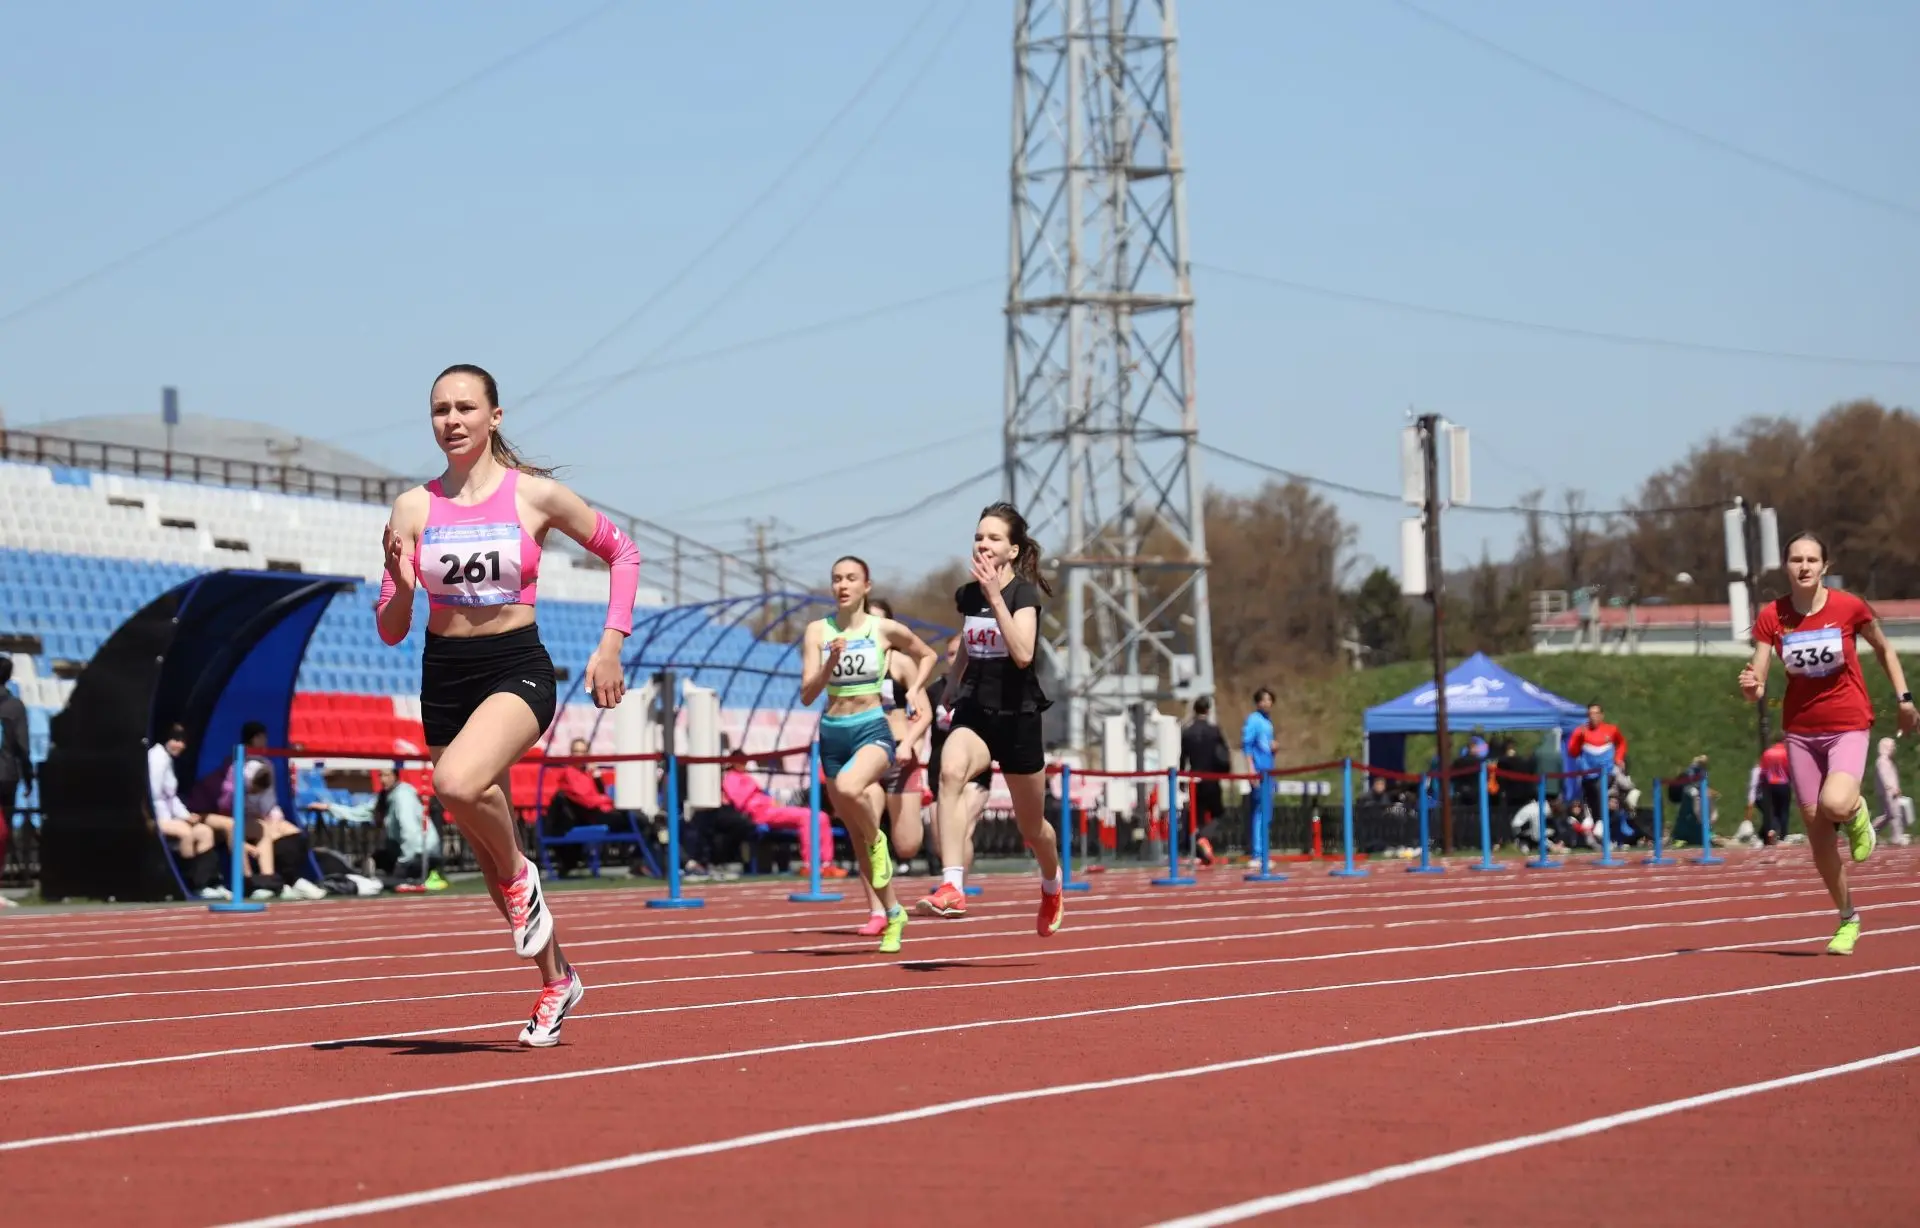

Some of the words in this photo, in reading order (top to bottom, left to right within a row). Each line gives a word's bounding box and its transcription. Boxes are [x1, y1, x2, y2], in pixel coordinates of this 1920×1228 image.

[439, 550, 500, 585] 261
[967, 628, 996, 647] 147
[1791, 646, 1835, 668] 336
